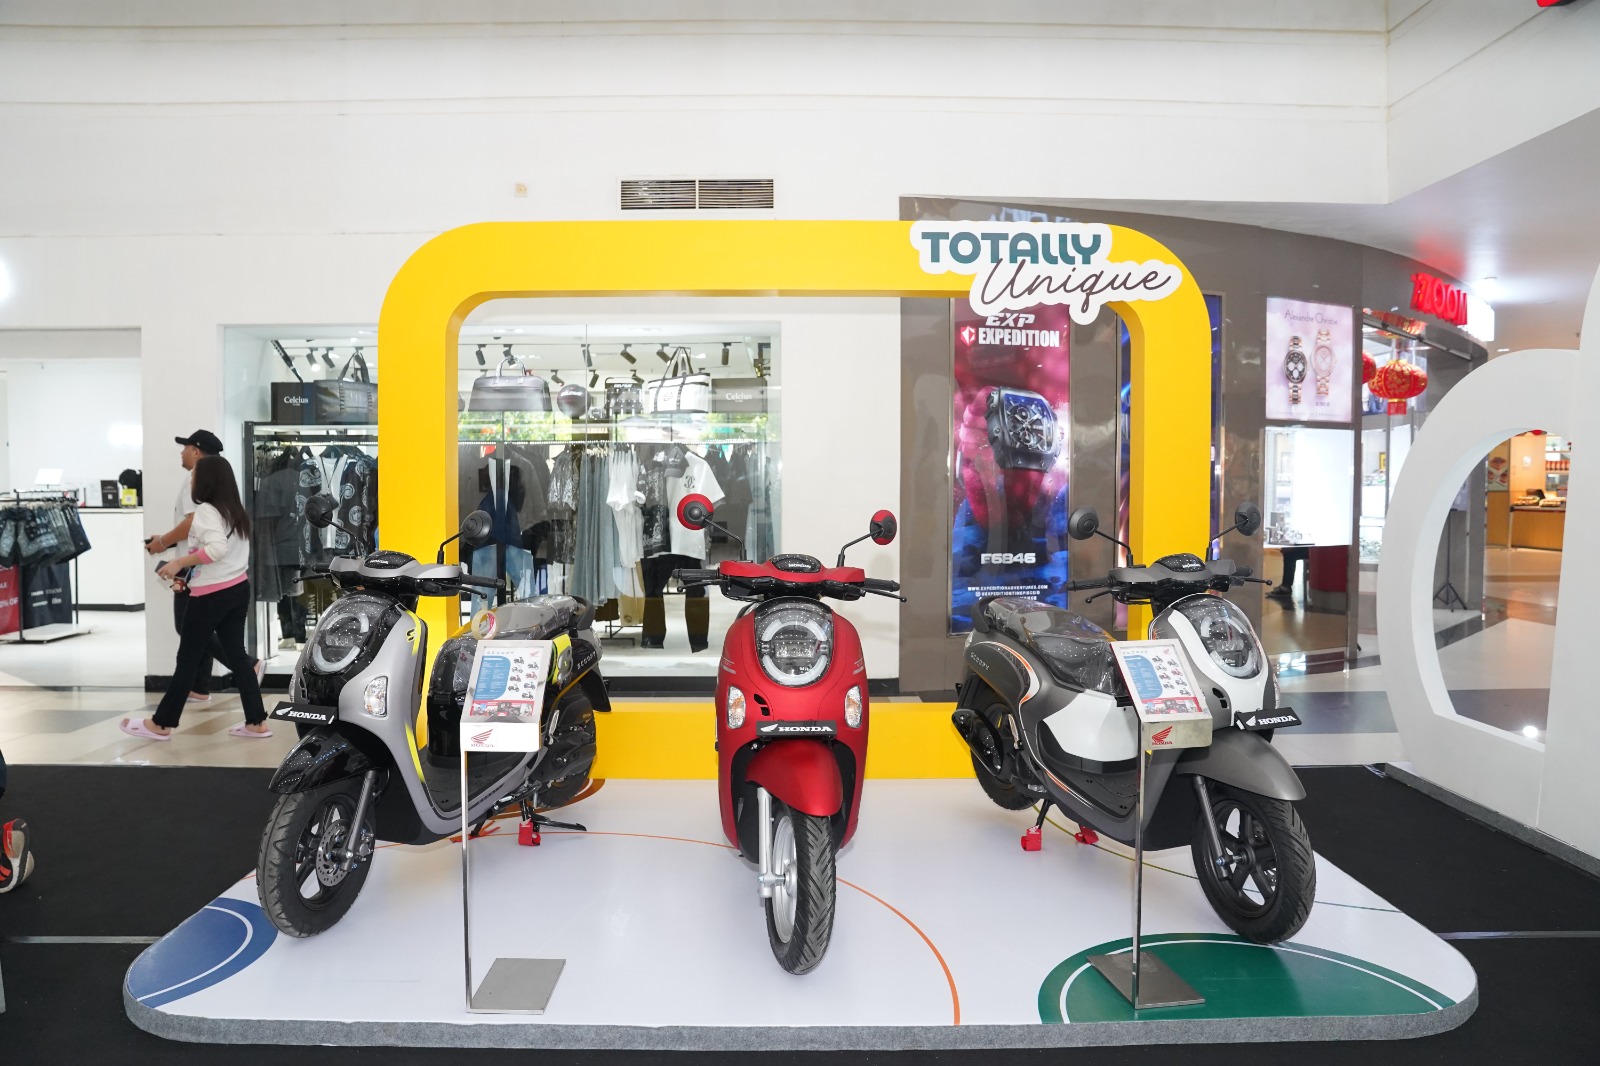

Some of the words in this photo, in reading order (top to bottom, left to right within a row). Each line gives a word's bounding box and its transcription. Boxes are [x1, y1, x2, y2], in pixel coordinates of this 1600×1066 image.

[921, 231, 1102, 265] TOTALLY
[981, 258, 1171, 314] Unique
[985, 312, 1036, 328] EXP
[1284, 309, 1314, 323] Alexandre
[978, 327, 1060, 348] EXPEDITION
[283, 396, 309, 404] Celcius
[725, 392, 753, 401] Celcius
[287, 710, 327, 721] HONDA
[1257, 715, 1298, 726] HONDA
